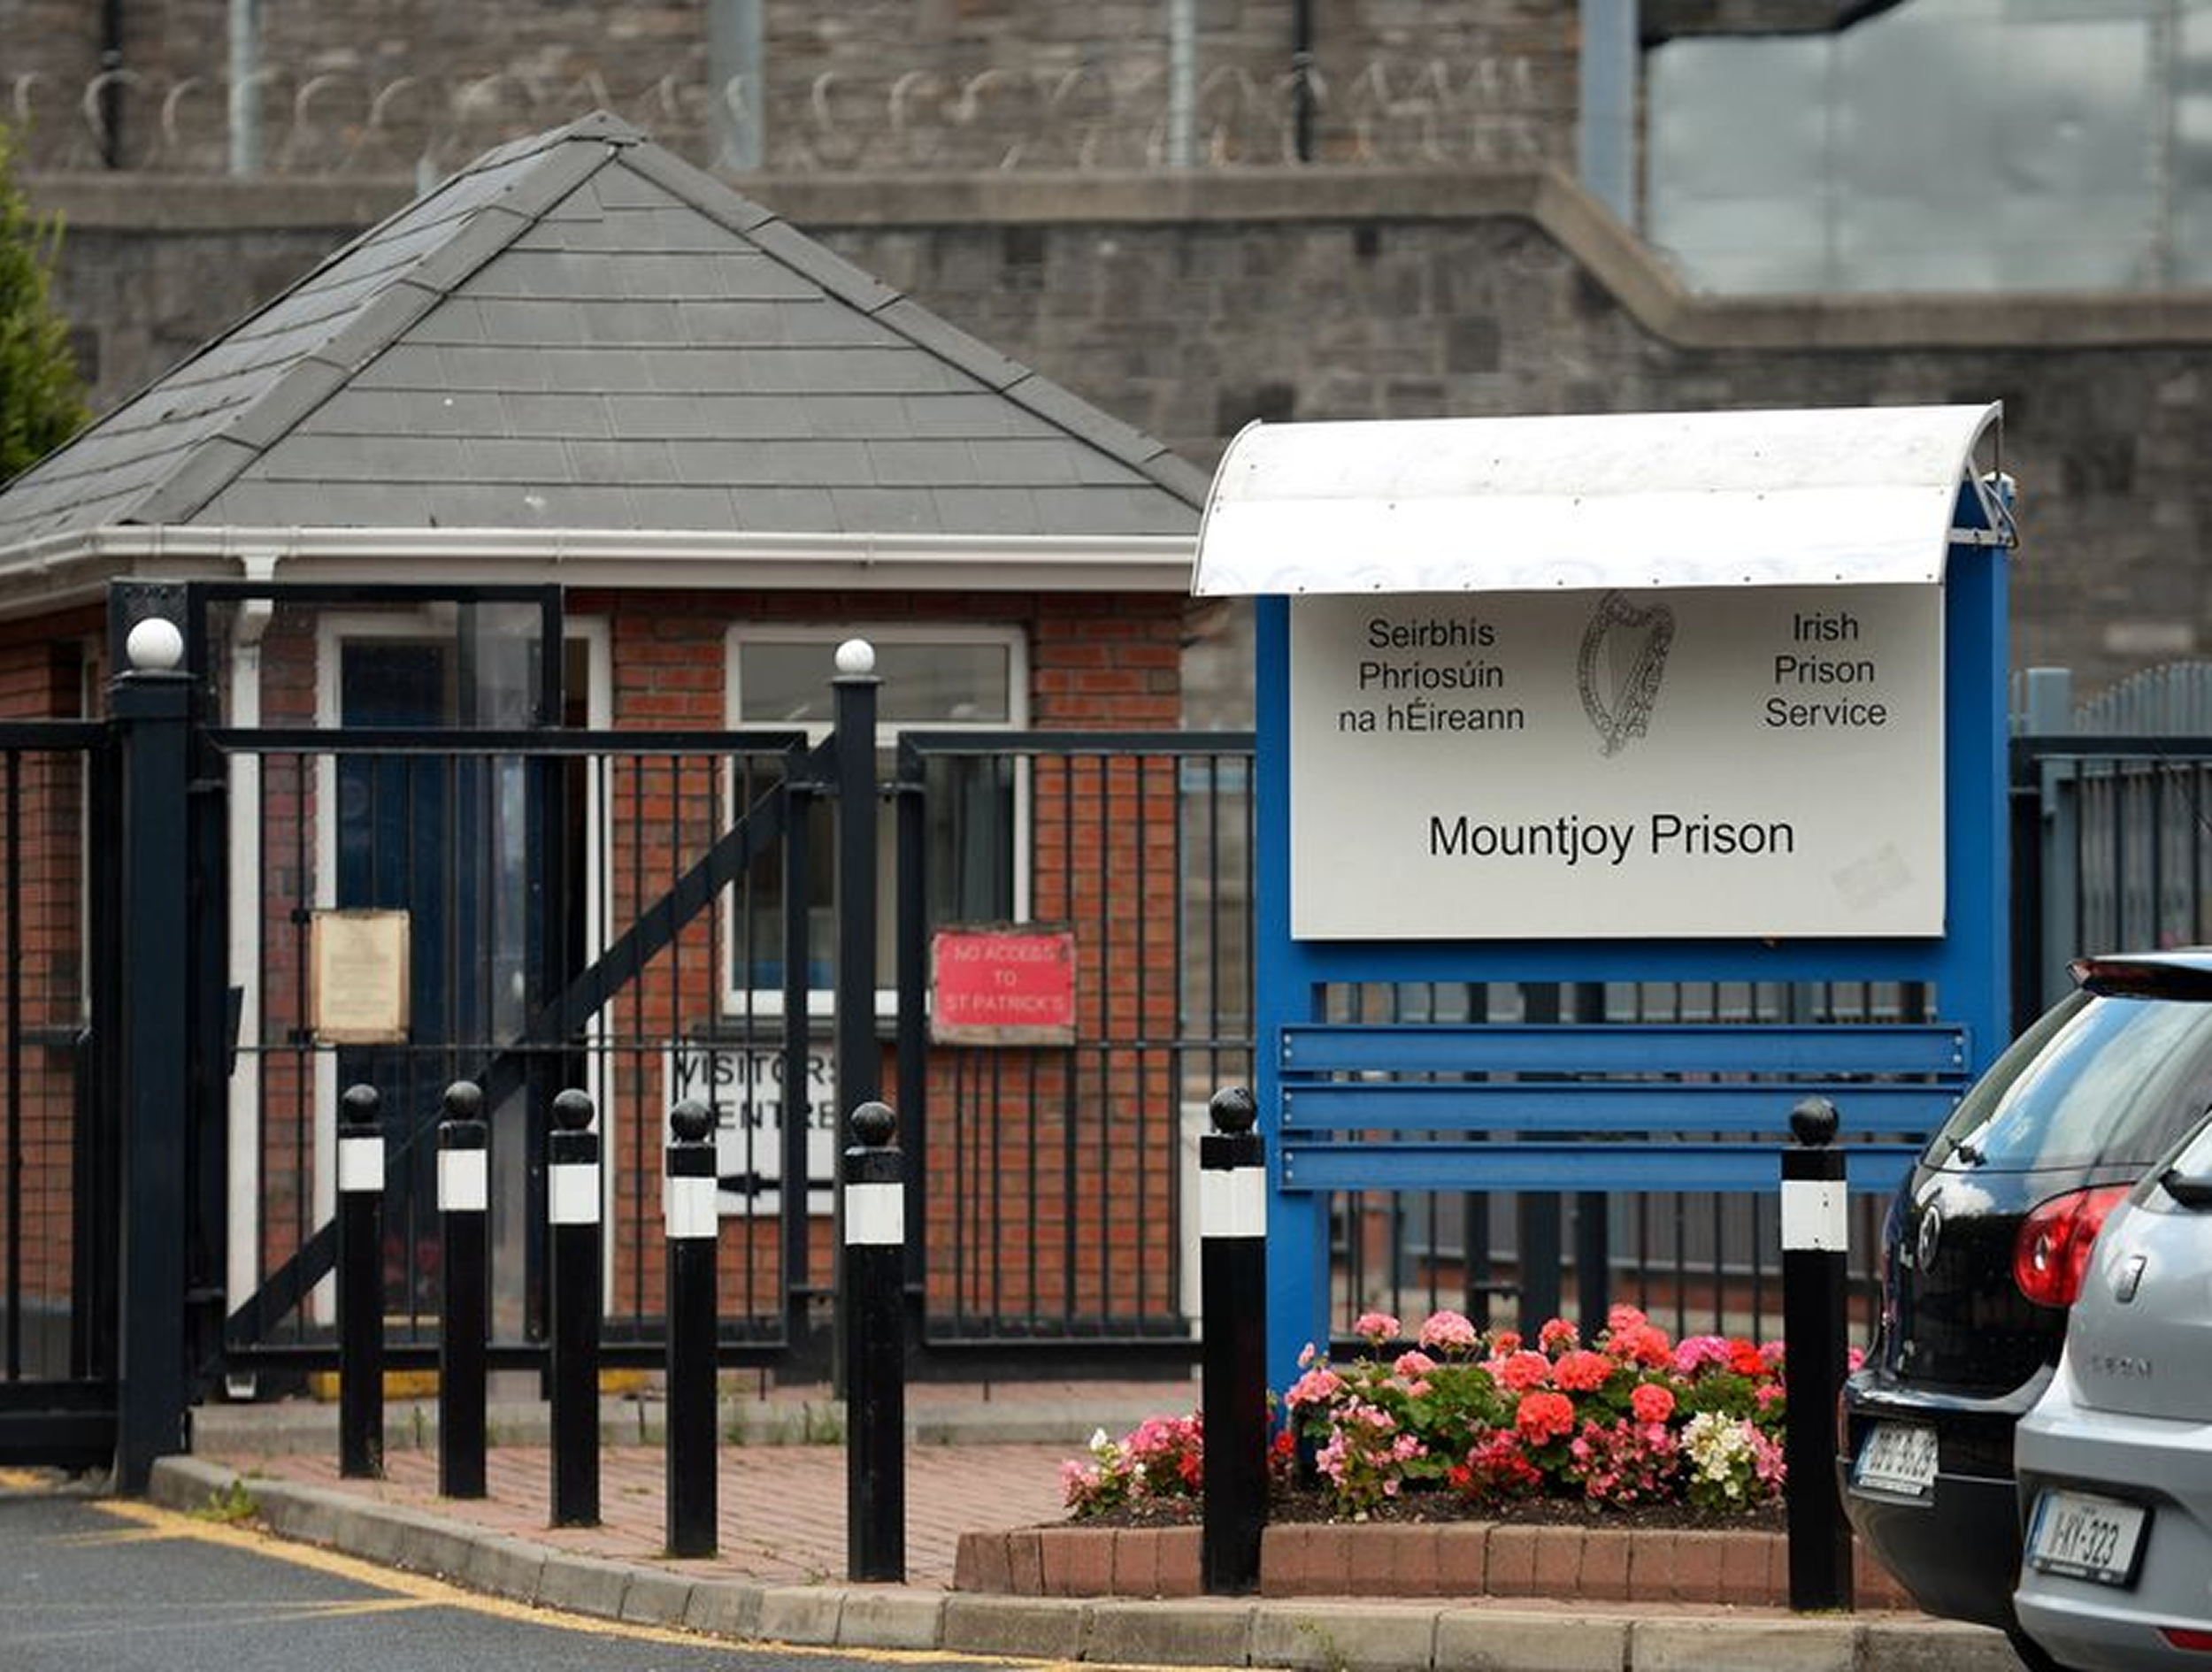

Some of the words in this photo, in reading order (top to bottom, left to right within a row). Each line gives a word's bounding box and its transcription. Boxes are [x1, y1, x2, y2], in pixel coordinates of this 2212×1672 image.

[1368, 617, 1496, 648] Seirbhís
[1793, 612, 1860, 642] Irish
[1775, 655, 1874, 684] Prison
[1339, 710, 1376, 732] na
[1386, 696, 1525, 732] hÉireann
[1765, 697, 1887, 727] Service
[1430, 815, 1634, 866] Mountjoy
[1652, 813, 1795, 855] Prison
[953, 945, 980, 962] NO
[982, 945, 1056, 963] ACCESS
[995, 970, 1018, 986] TO
[675, 1055, 836, 1085] VISITR
